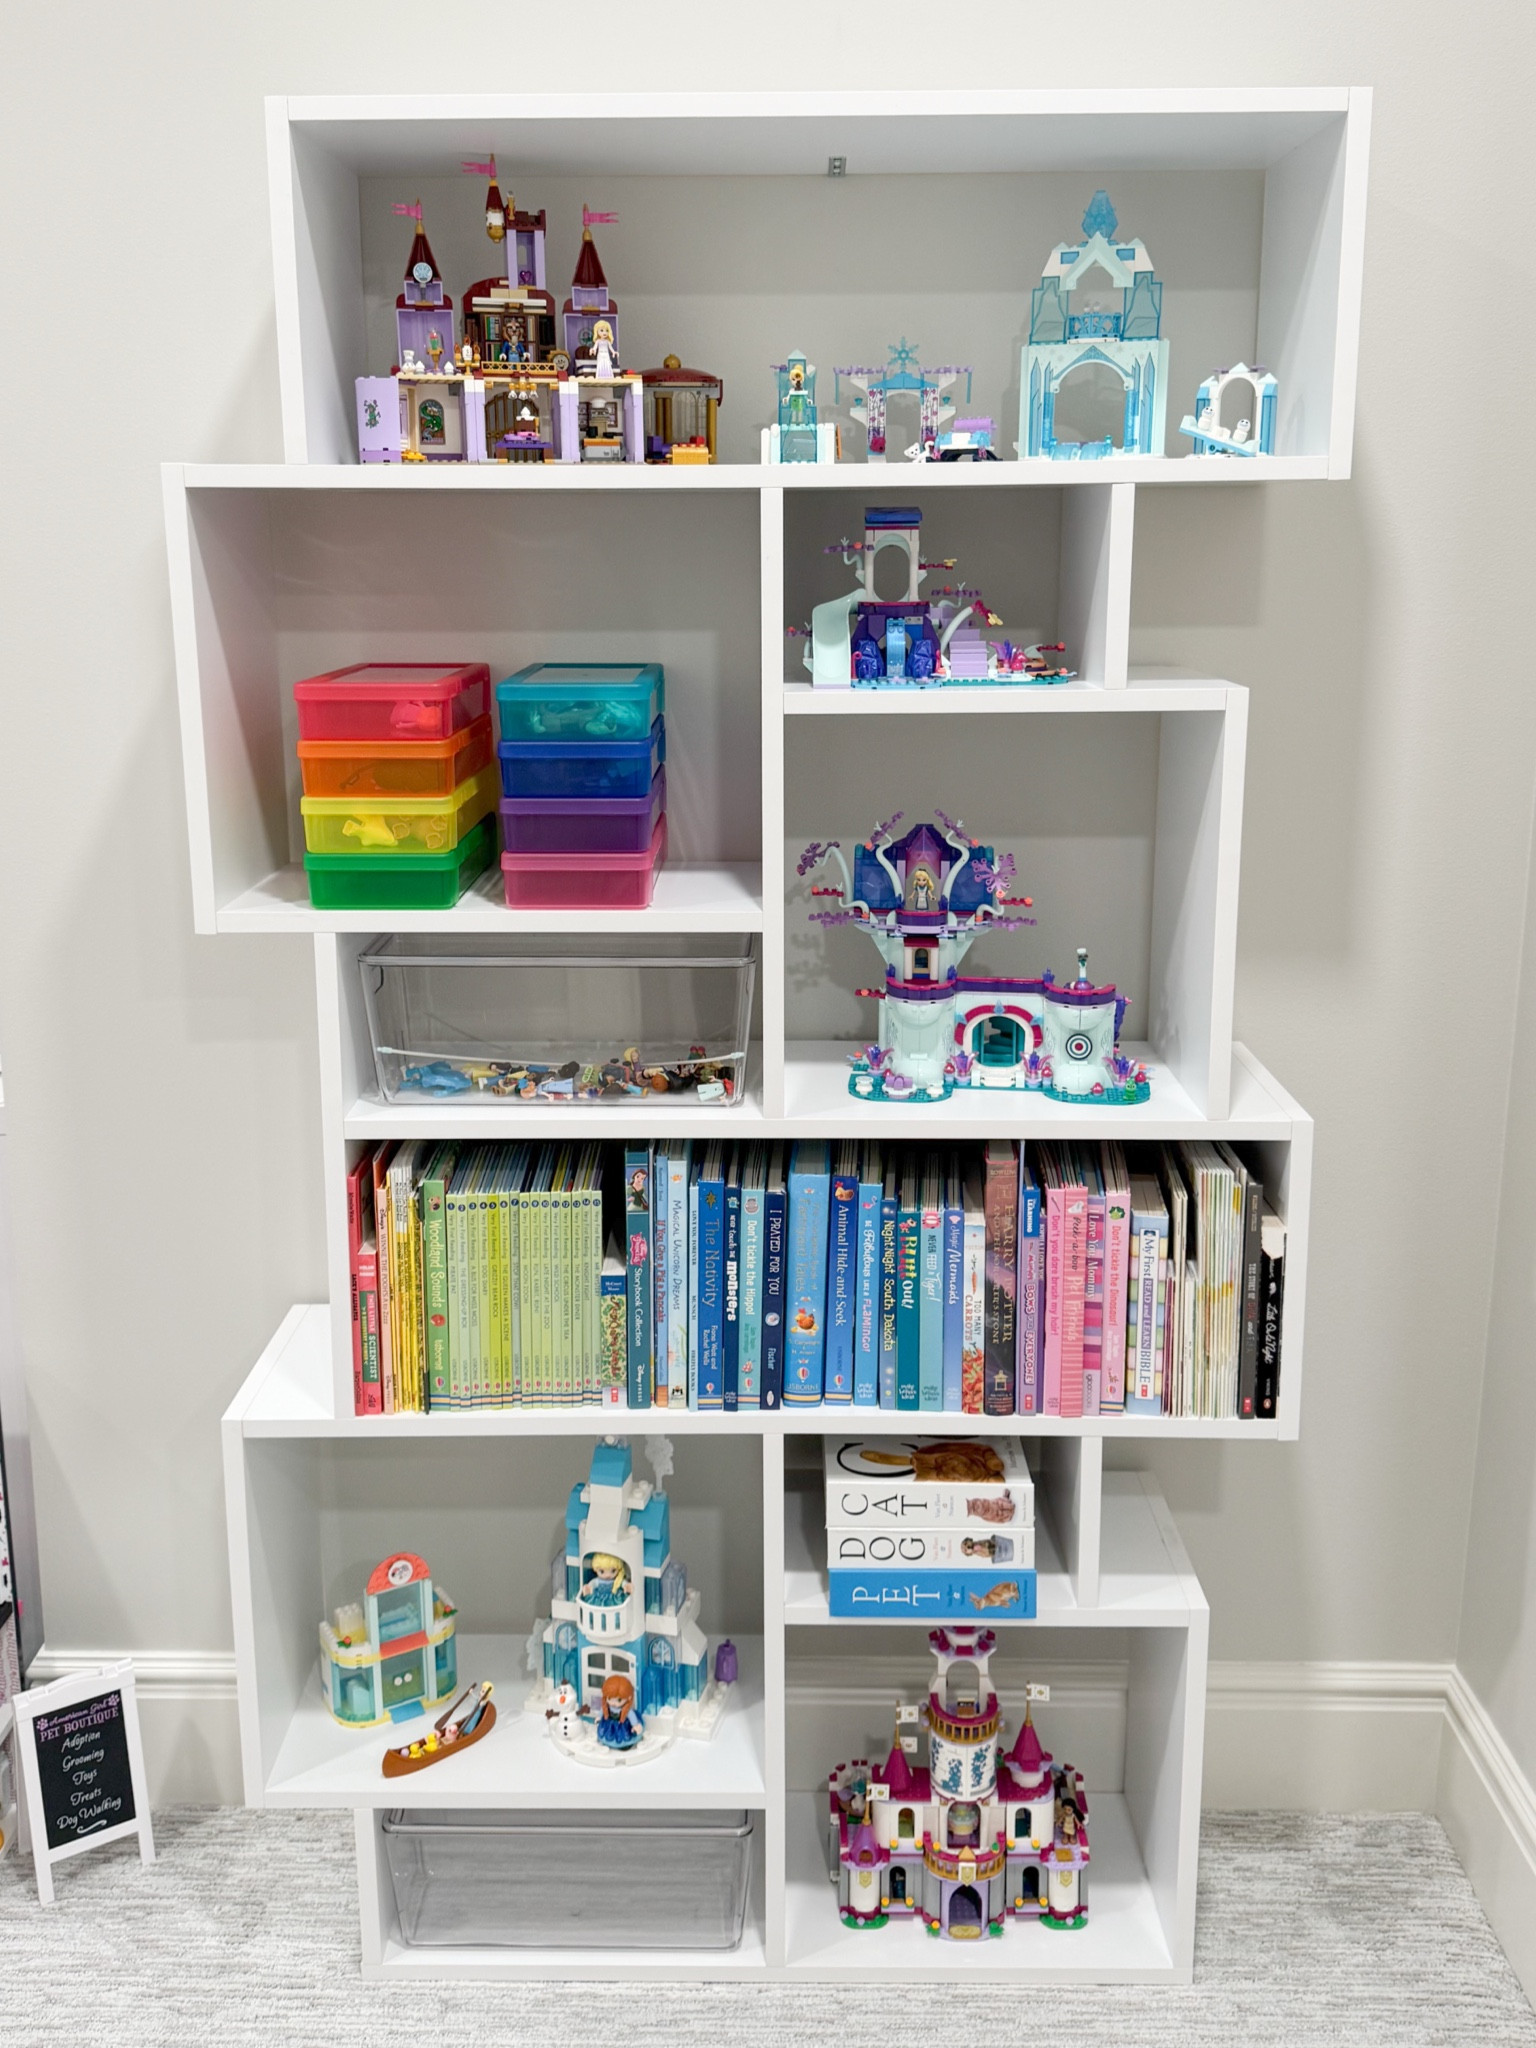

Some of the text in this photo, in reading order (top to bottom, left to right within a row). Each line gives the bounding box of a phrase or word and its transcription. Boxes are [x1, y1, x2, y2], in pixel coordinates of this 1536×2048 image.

[657, 1228, 665, 1242] You
[747, 1220, 757, 1242] Don't
[769, 1218, 781, 1252] PRAYED
[1088, 1215, 1099, 1237] Love
[1112, 1225, 1121, 1246] Don't
[657, 1244, 665, 1261] Give
[747, 1245, 757, 1268] tickle
[795, 1198, 811, 1292] Farmyard Tales
[863, 1229, 875, 1277] Fabulous
[927, 1234, 937, 1252] NEVER
[1143, 1238, 1154, 1255] My
[429, 1219, 444, 1308] Woodland Sounds
[702, 1219, 720, 1307] The Nativity
[770, 1256, 780, 1273] FOR
[835, 1205, 849, 1326] Animal Hide-and-Seek
[927, 1254, 937, 1270] FEED
[948, 1225, 962, 1305] Magic Mermaids
[1111, 1249, 1120, 1271] tickle
[1144, 1256, 1154, 1277] First
[633, 1267, 643, 1307] Storybook
[746, 1271, 756, 1286] the
[768, 1277, 780, 1295] YOU
[921, 1271, 942, 1302] Tiger!
[1003, 1205, 1014, 1343] HARRY POTTER
[1049, 1215, 1061, 1336] Don't you dare brush my hair!
[1067, 1277, 1083, 1295] Pet
[1087, 1260, 1099, 1299] Mommy
[1111, 1273, 1120, 1287] the
[1248, 1276, 1256, 1291] STORY
[726, 1260, 738, 1321] monsters
[745, 1288, 756, 1315] Hippo!
[883, 1278, 895, 1310] South
[901, 1280, 915, 1309] Out!
[1025, 1284, 1035, 1314] BOWS
[1144, 1280, 1152, 1303] READ
[657, 1291, 666, 1323] Pancake
[964, 1295, 973, 1341] CARROTS
[1109, 1289, 1119, 1326] Dinosaur!
[635, 1308, 643, 1346] Collection
[883, 1314, 895, 1351] Dakota
[974, 1316, 982, 1336] MANY
[1067, 1301, 1082, 1341] Friends
[1143, 1320, 1151, 1349] LEARN
[369, 1335, 377, 1379] SCIENTIST
[767, 1348, 776, 1370] Fischer
[1024, 1330, 1035, 1385] EVERYONE!
[1140, 1350, 1151, 1383] BIBLE
[636, 1363, 645, 1383] Disney
[841, 1493, 928, 1517] CAT
[840, 1536, 925, 1560] DOG
[852, 1585, 941, 1606] PET
[40, 1706, 119, 1743] PET BOUTIQUE
[48, 1699, 108, 1727] American Girl
[61, 1731, 101, 1753] Adoption
[62, 1748, 105, 1772] Grooming
[72, 1768, 98, 1785] Toys
[70, 1787, 102, 1806] Treats
[57, 1796, 122, 1829] Dog Walking
